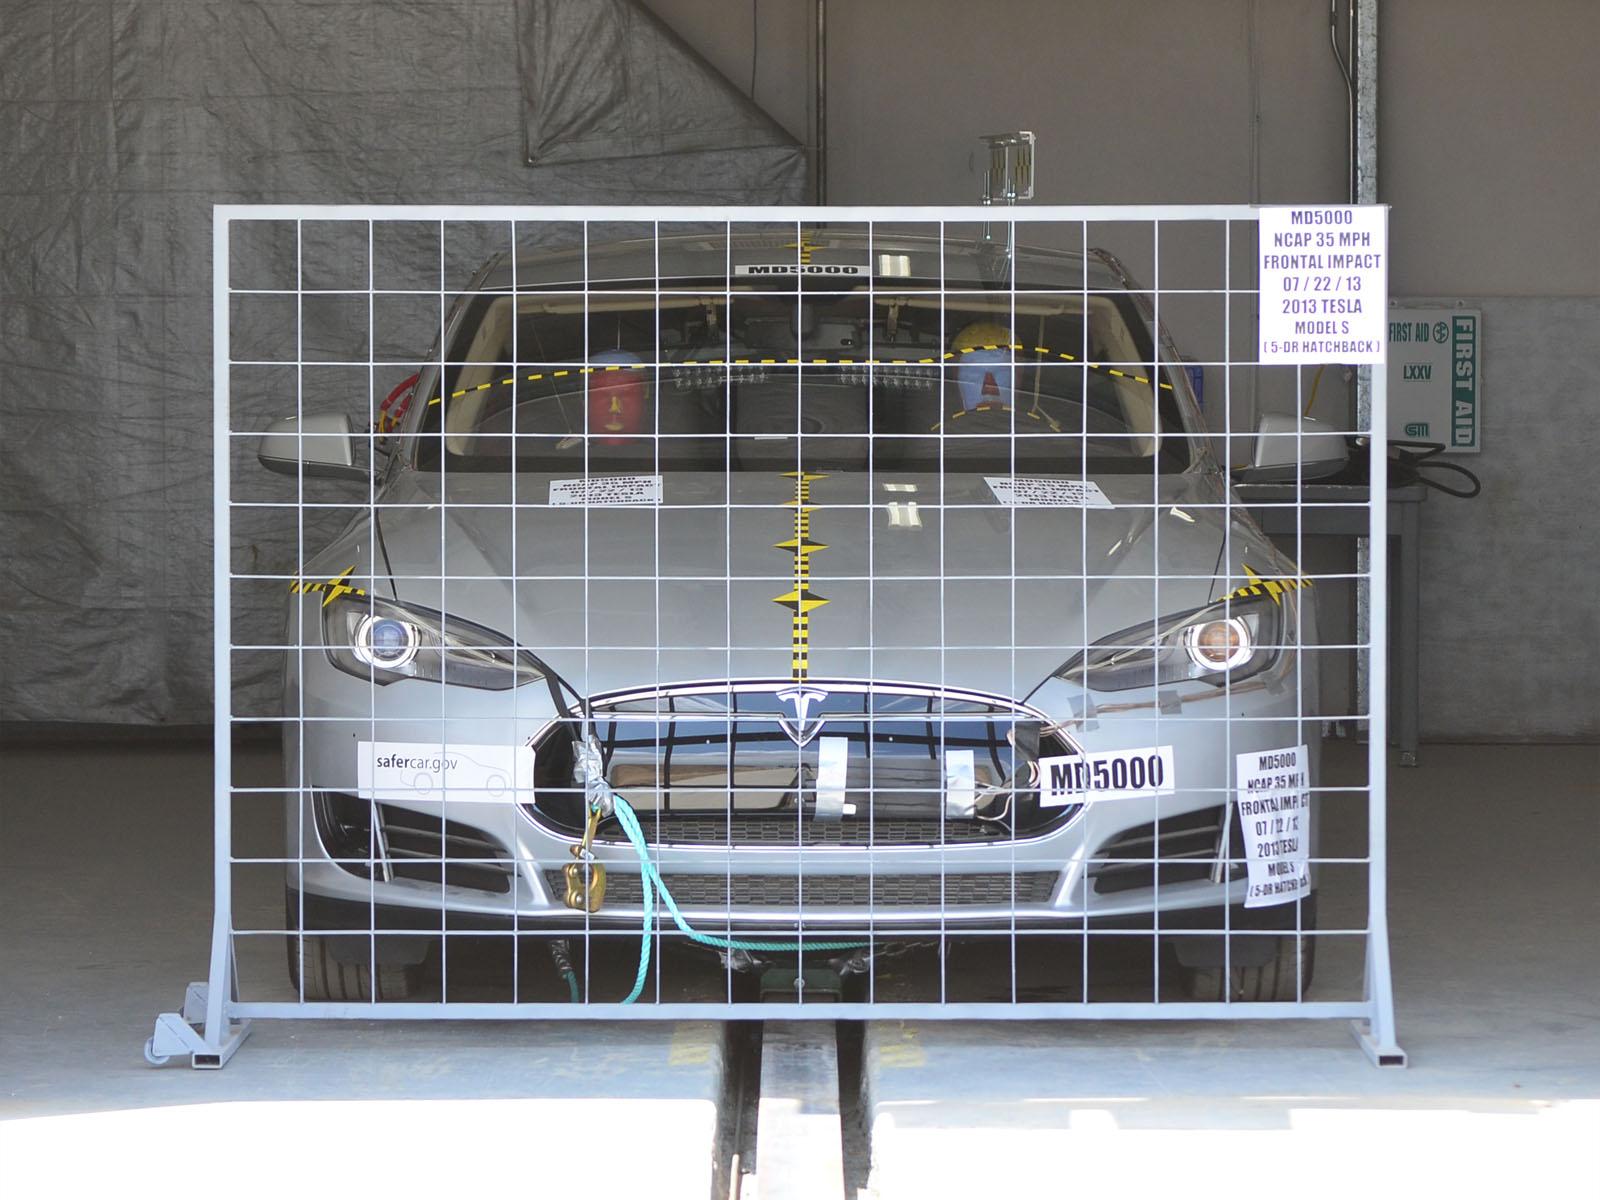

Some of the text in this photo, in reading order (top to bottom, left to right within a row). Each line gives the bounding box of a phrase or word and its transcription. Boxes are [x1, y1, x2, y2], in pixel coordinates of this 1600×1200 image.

[1291, 210, 1353, 225] MD5000
[1274, 231, 1371, 247] NCAP 35 MPH
[1263, 254, 1382, 269] FRONTAL IMPACT
[747, 266, 859, 274] MD5000
[1283, 276, 1299, 291] 07
[1313, 276, 1331, 291] 22
[1345, 276, 1361, 291] 13
[1282, 299, 1363, 314] 2013 TESLA
[1295, 320, 1350, 335] MODEL S
[1389, 322, 1430, 342] FIRST AID
[1302, 341, 1374, 353] HATCHBACK
[1403, 365, 1432, 380] LXXV
[1455, 319, 1473, 445] FIRST AID
[376, 753, 458, 773] safercar.gov
[1259, 752, 1297, 771] MD5000
[1050, 755, 1164, 796] MD5000
